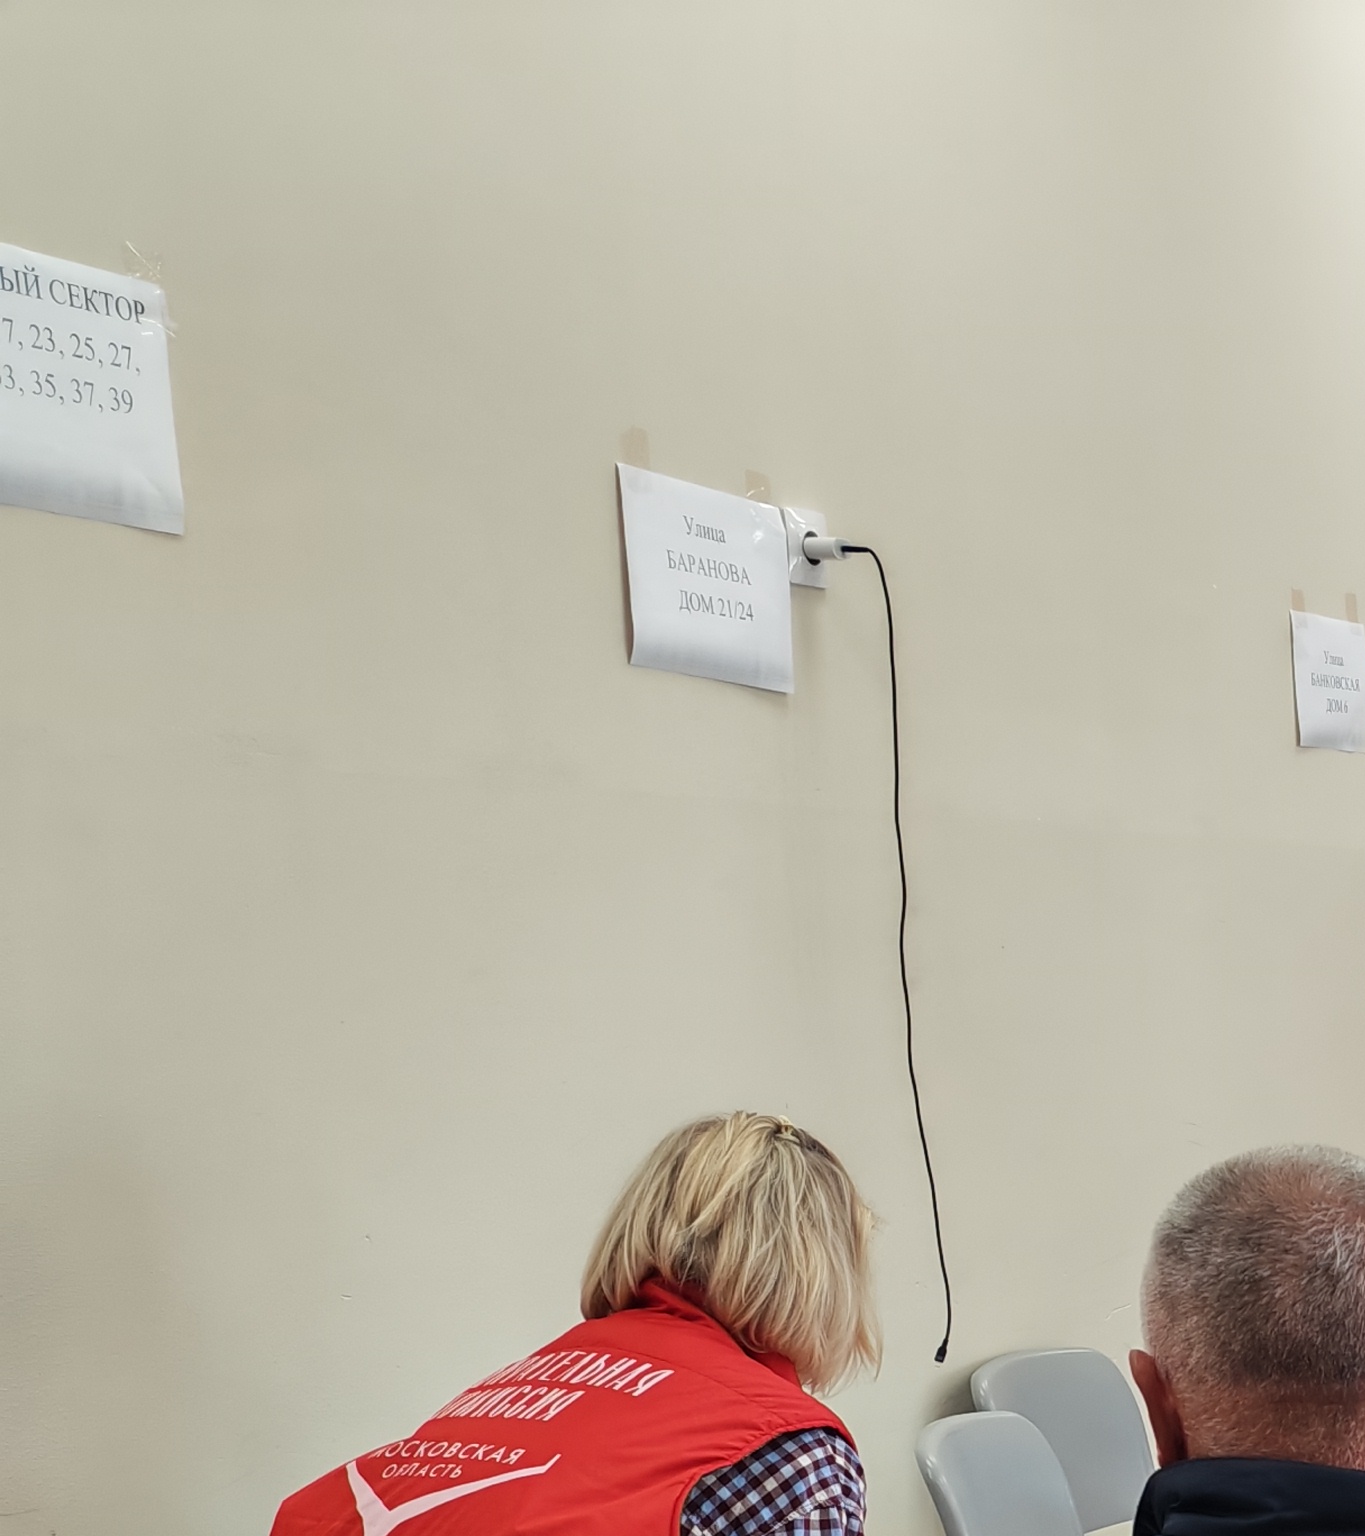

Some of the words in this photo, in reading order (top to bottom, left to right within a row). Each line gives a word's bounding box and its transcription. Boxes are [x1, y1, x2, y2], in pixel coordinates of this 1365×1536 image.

[49, 279, 145, 325] СЕКТОР
[29, 324, 65, 360] 23,
[69, 333, 103, 368] 25,
[0, 364, 25, 396] 3,
[30, 370, 65, 405] 35,
[70, 378, 104, 413] 37,
[108, 387, 134, 413] 39
[682, 515, 727, 543] Улица
[666, 549, 752, 585] БАРАНОВА
[679, 589, 715, 614] ДОМ
[717, 597, 755, 622] 21/24
[1310, 672, 1360, 692] БАНКОВСКАЯ
[1325, 698, 1342, 714] ДОМ
